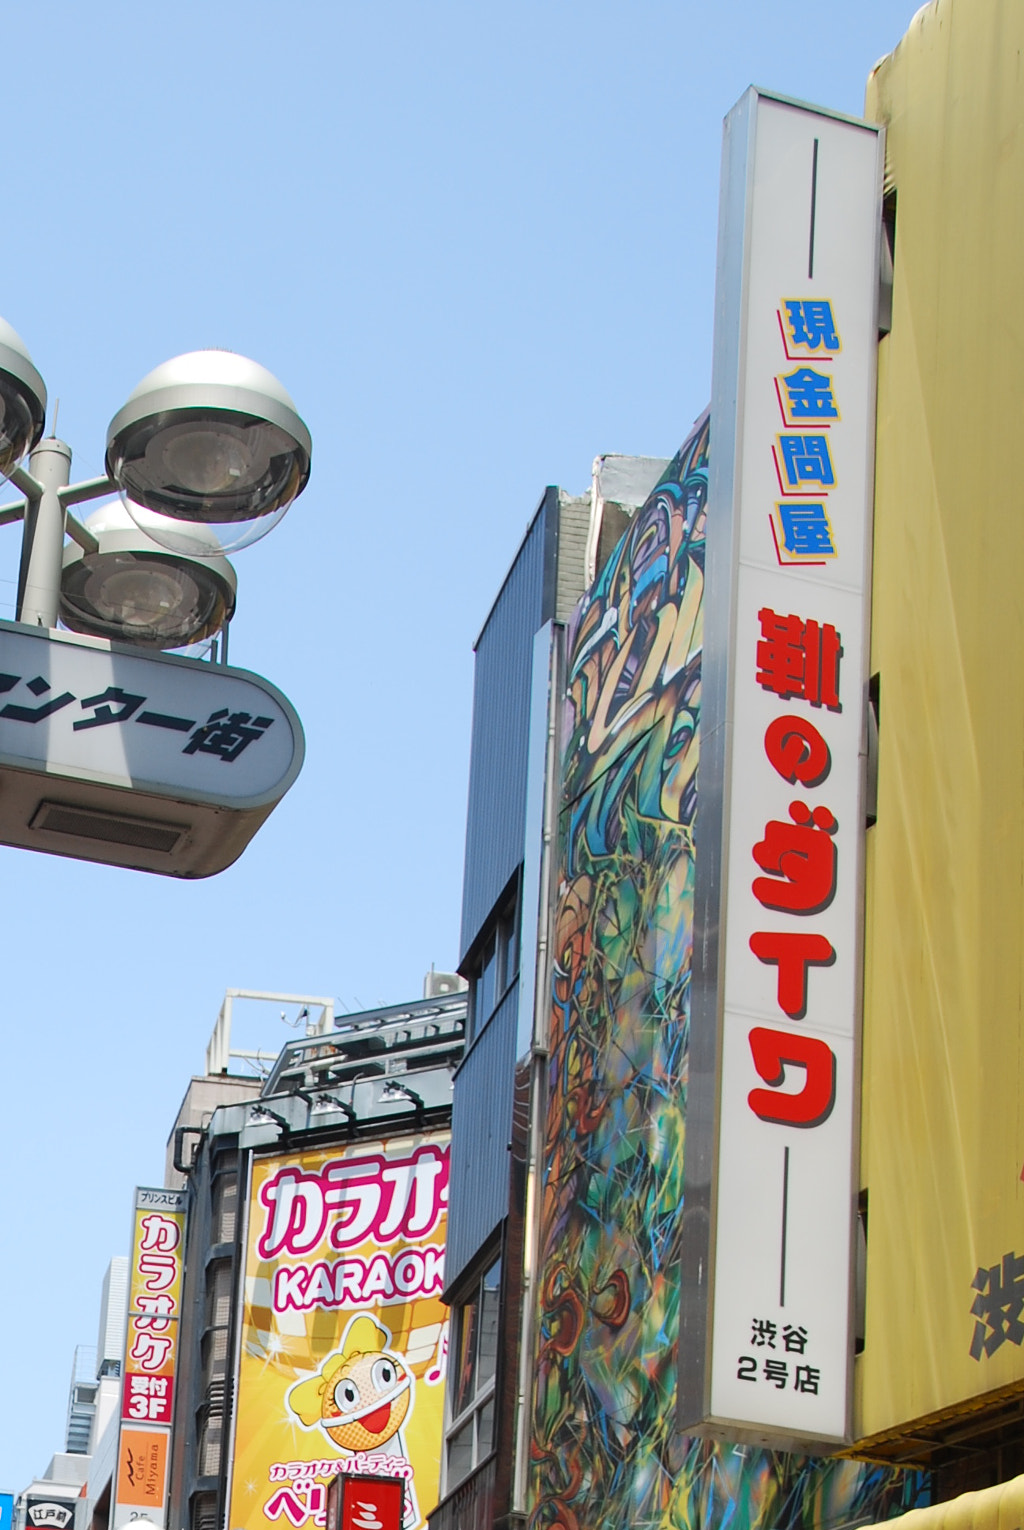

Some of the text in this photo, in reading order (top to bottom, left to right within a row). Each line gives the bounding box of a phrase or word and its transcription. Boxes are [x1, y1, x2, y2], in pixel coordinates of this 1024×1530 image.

[774, 298, 843, 563] 現金問屋
[141, 1192, 182, 1205] プリンスビル
[259, 1146, 450, 1261] カラオ
[130, 1214, 181, 1373] カラオケ
[750, 1318, 808, 1355] 渋谷
[129, 1378, 168, 1398] 受付
[737, 1355, 821, 1396] 2号店
[128, 1398, 168, 1419] 3F
[146, 1443, 159, 1496] Miyama
